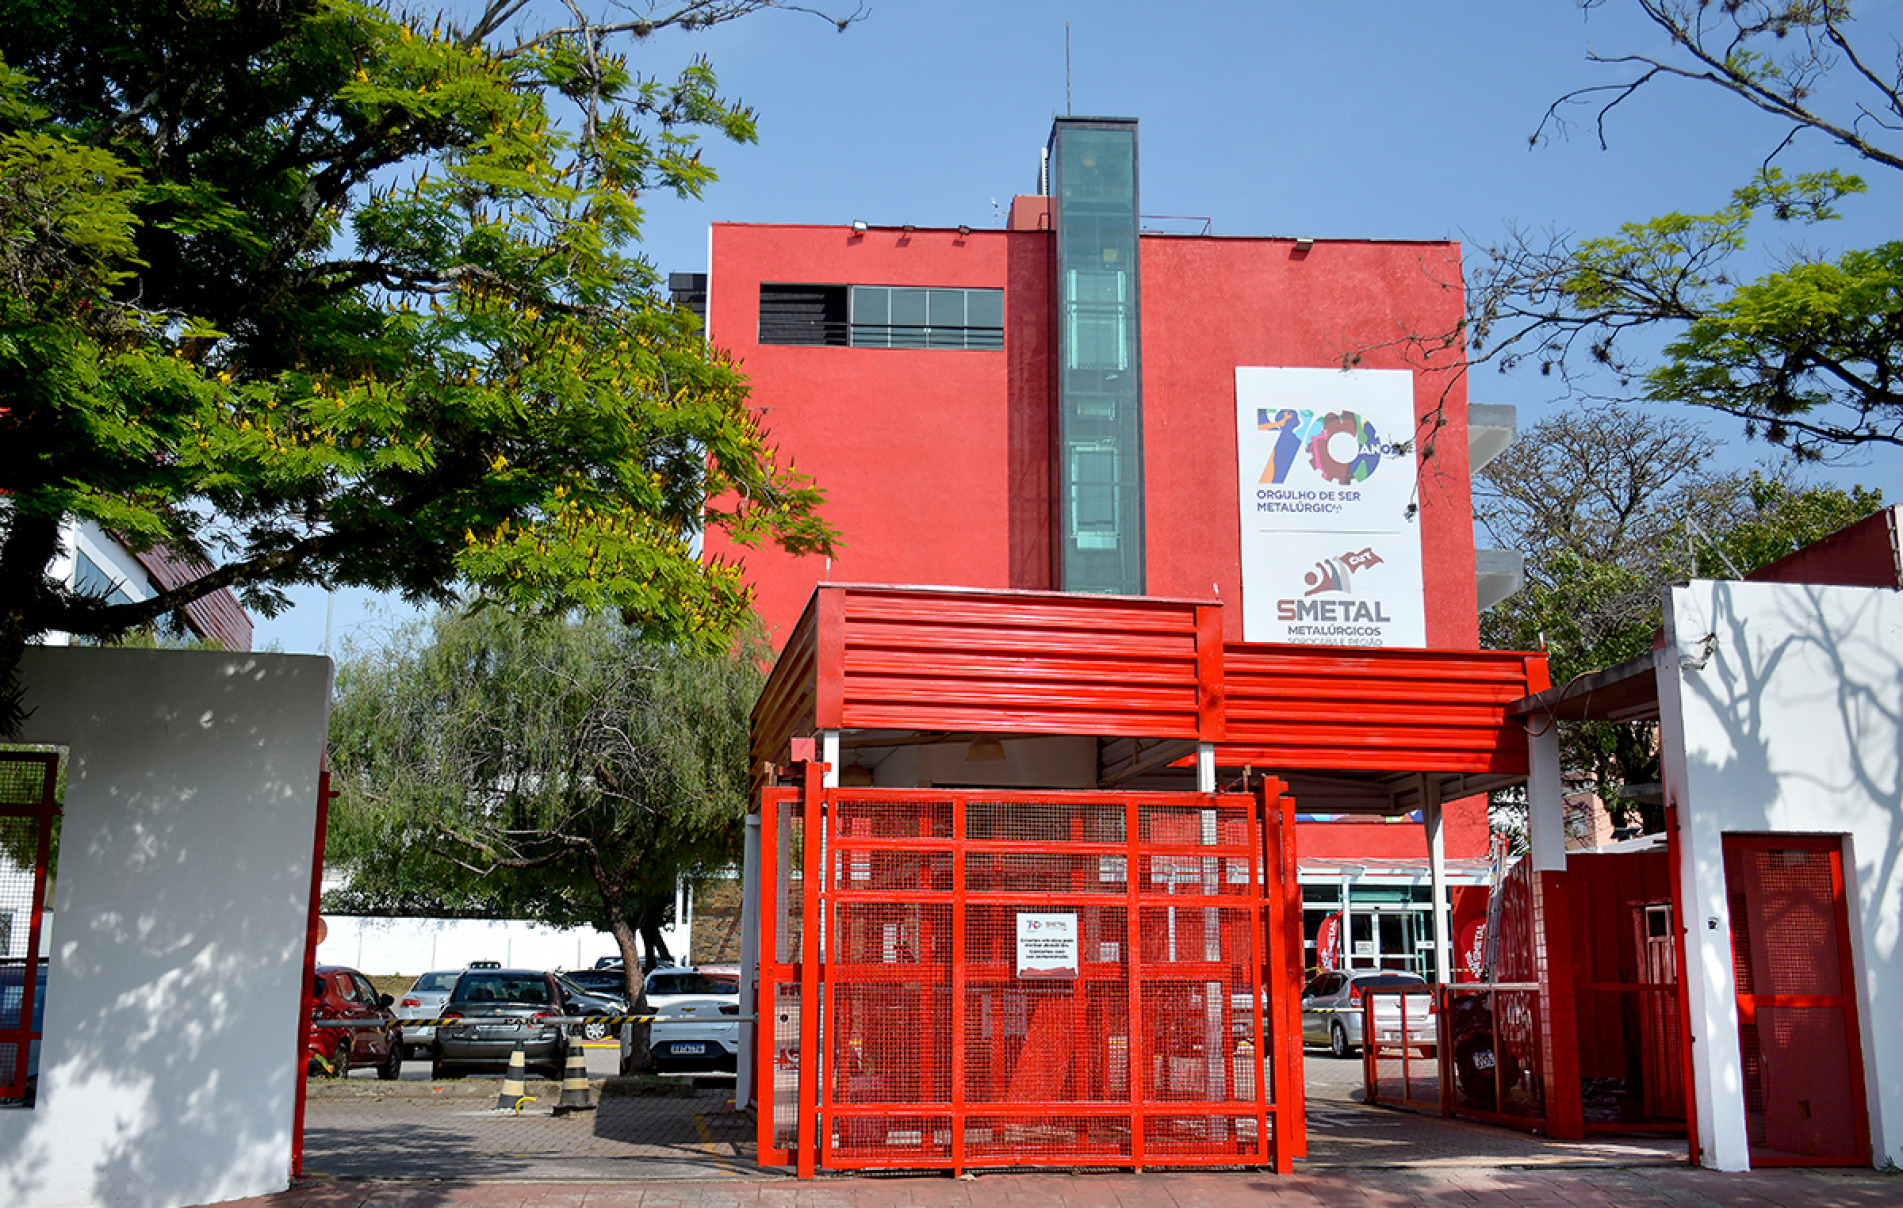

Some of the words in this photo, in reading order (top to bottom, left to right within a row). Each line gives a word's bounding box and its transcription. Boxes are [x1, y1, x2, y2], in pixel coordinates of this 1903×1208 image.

[1257, 409, 1381, 485] 70
[1256, 489, 1317, 500] ORGULHO
[1319, 491, 1336, 501] DE
[1338, 491, 1362, 501] SER
[1277, 599, 1391, 622] SMETAL
[1287, 623, 1382, 636] METALÚRGICOS
